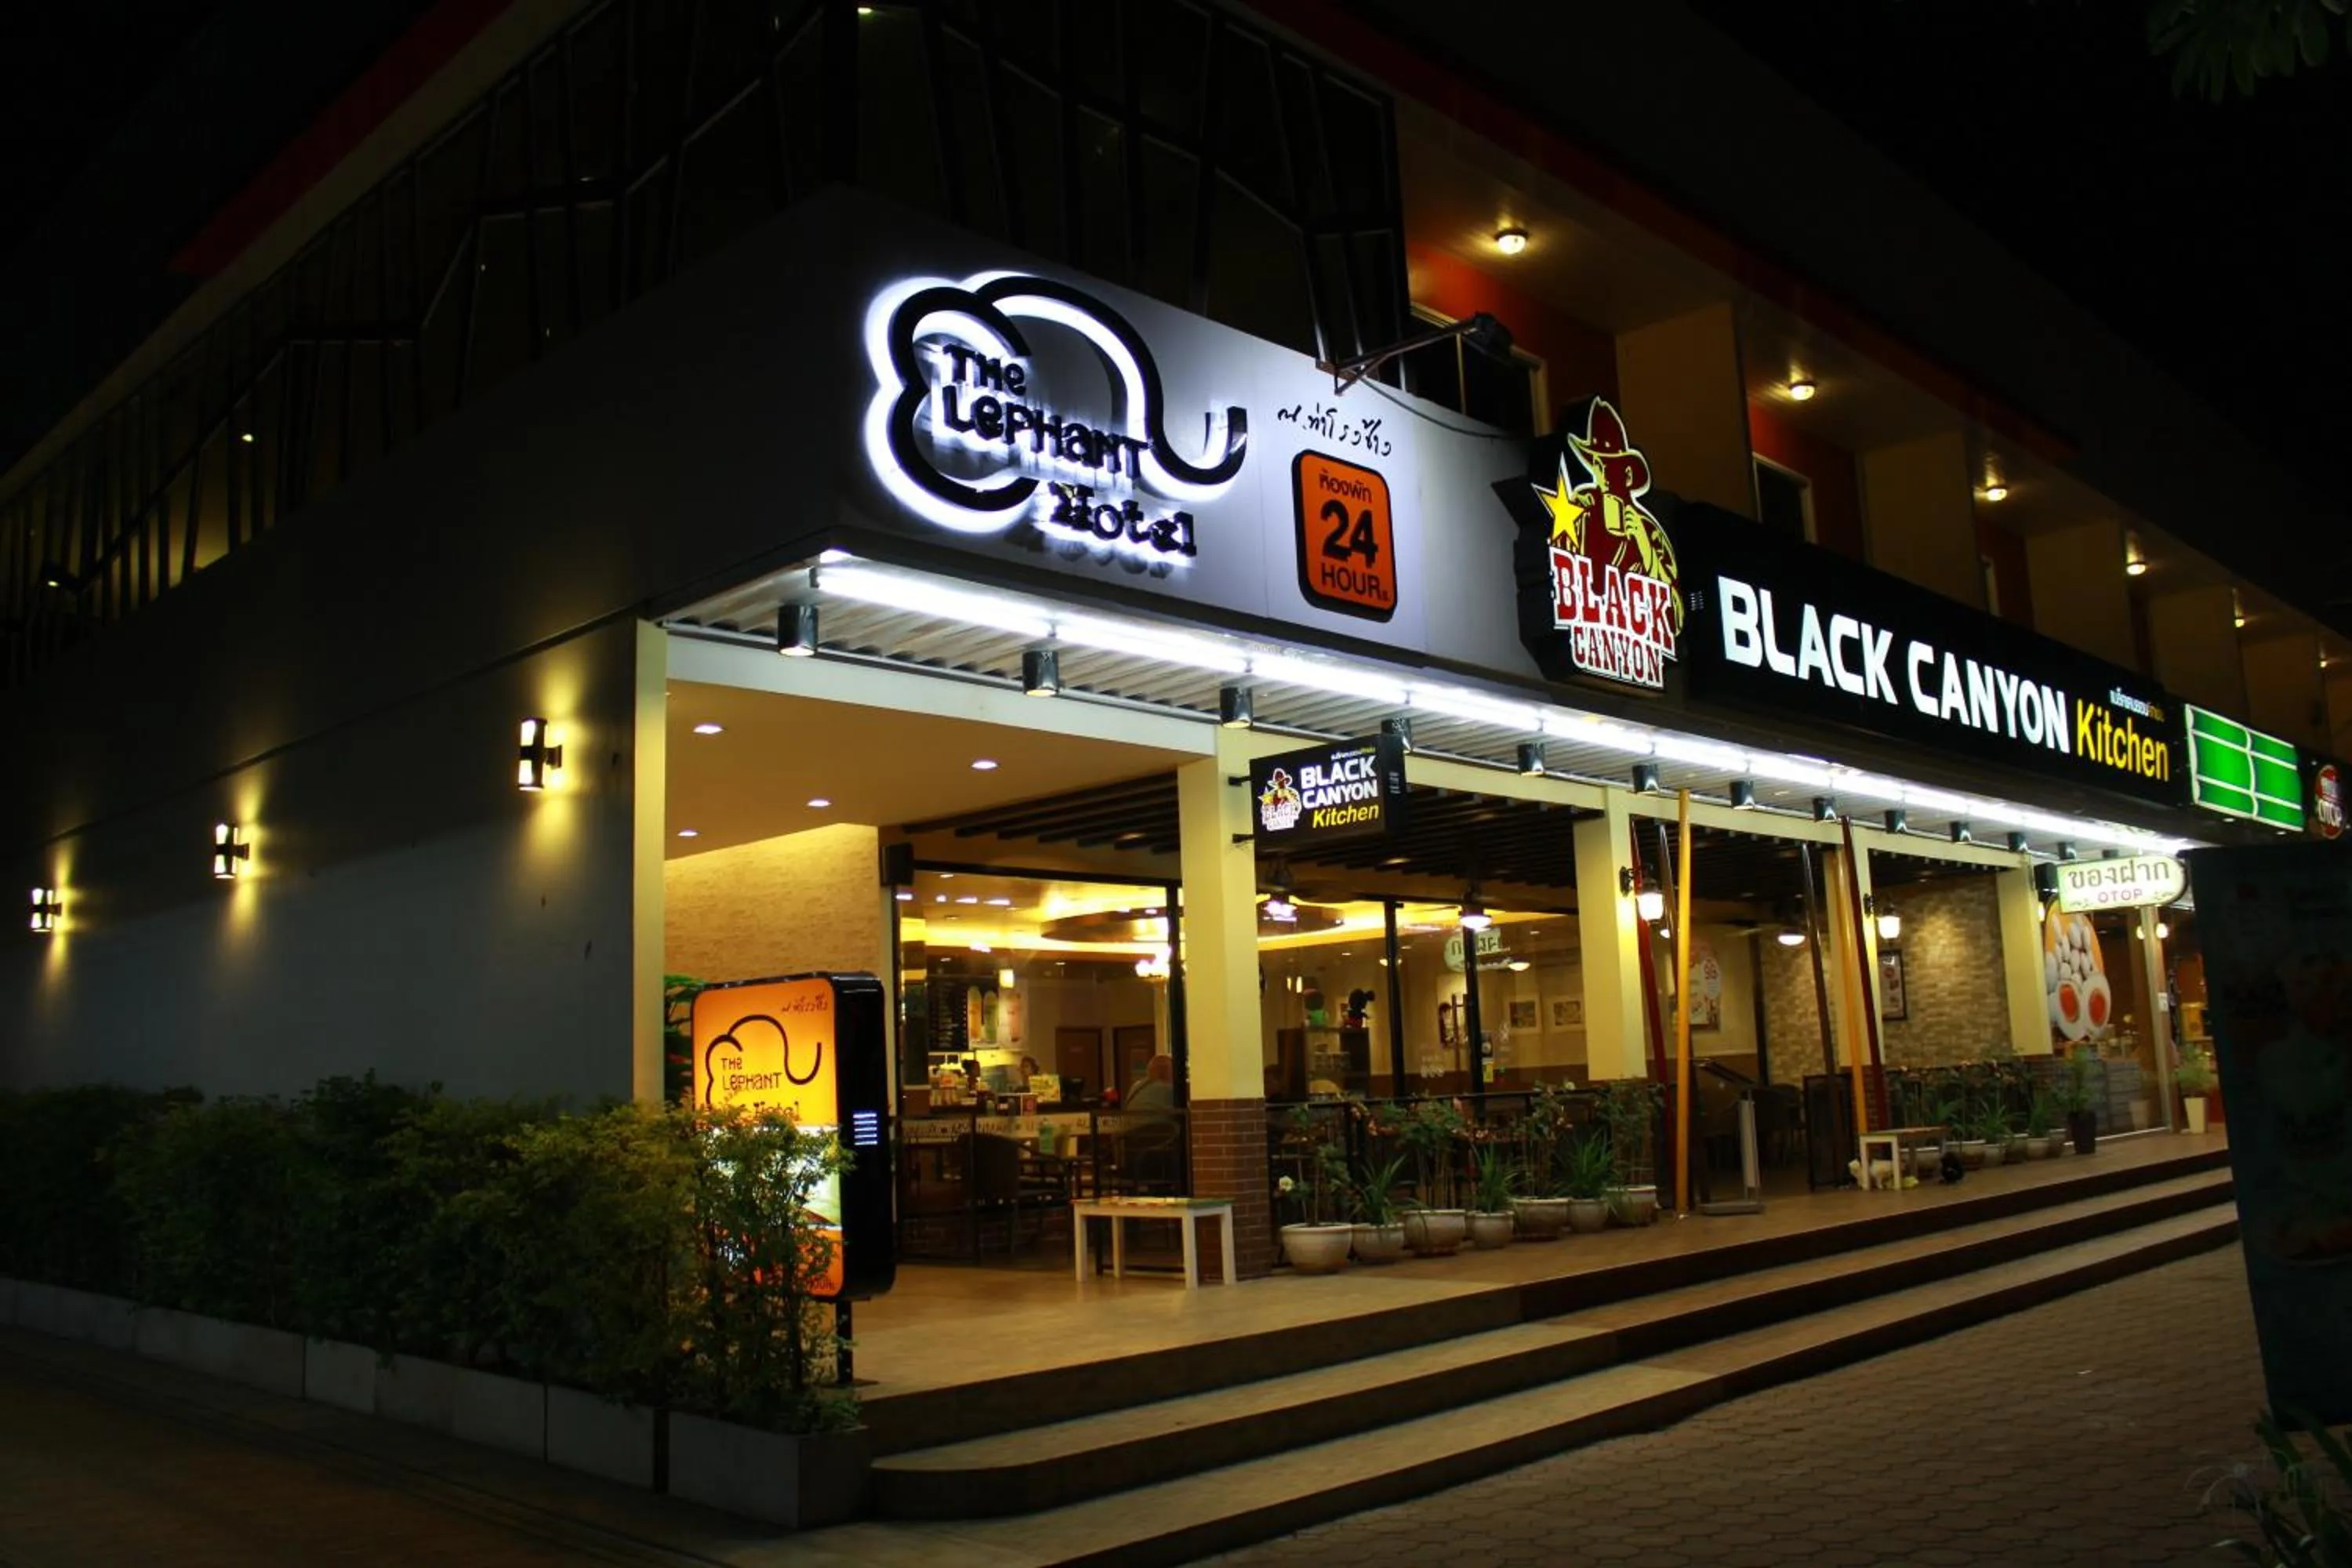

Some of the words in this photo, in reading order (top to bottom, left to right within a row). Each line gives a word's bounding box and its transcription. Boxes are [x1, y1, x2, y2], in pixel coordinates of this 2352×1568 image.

[1320, 499, 1379, 568] 24
[1552, 549, 1673, 652] BLACK
[1572, 626, 1661, 683] CANYON
[1717, 575, 1898, 706] BLACK
[1907, 640, 2071, 755] CANYON
[2077, 698, 2169, 782] Kitchen
[1300, 754, 1377, 790] BLACK
[1301, 779, 1379, 809] CANYON
[1312, 804, 1380, 829] Kitchen
[2068, 859, 2170, 890] ของฝาก
[2097, 888, 2143, 904] OTOP
